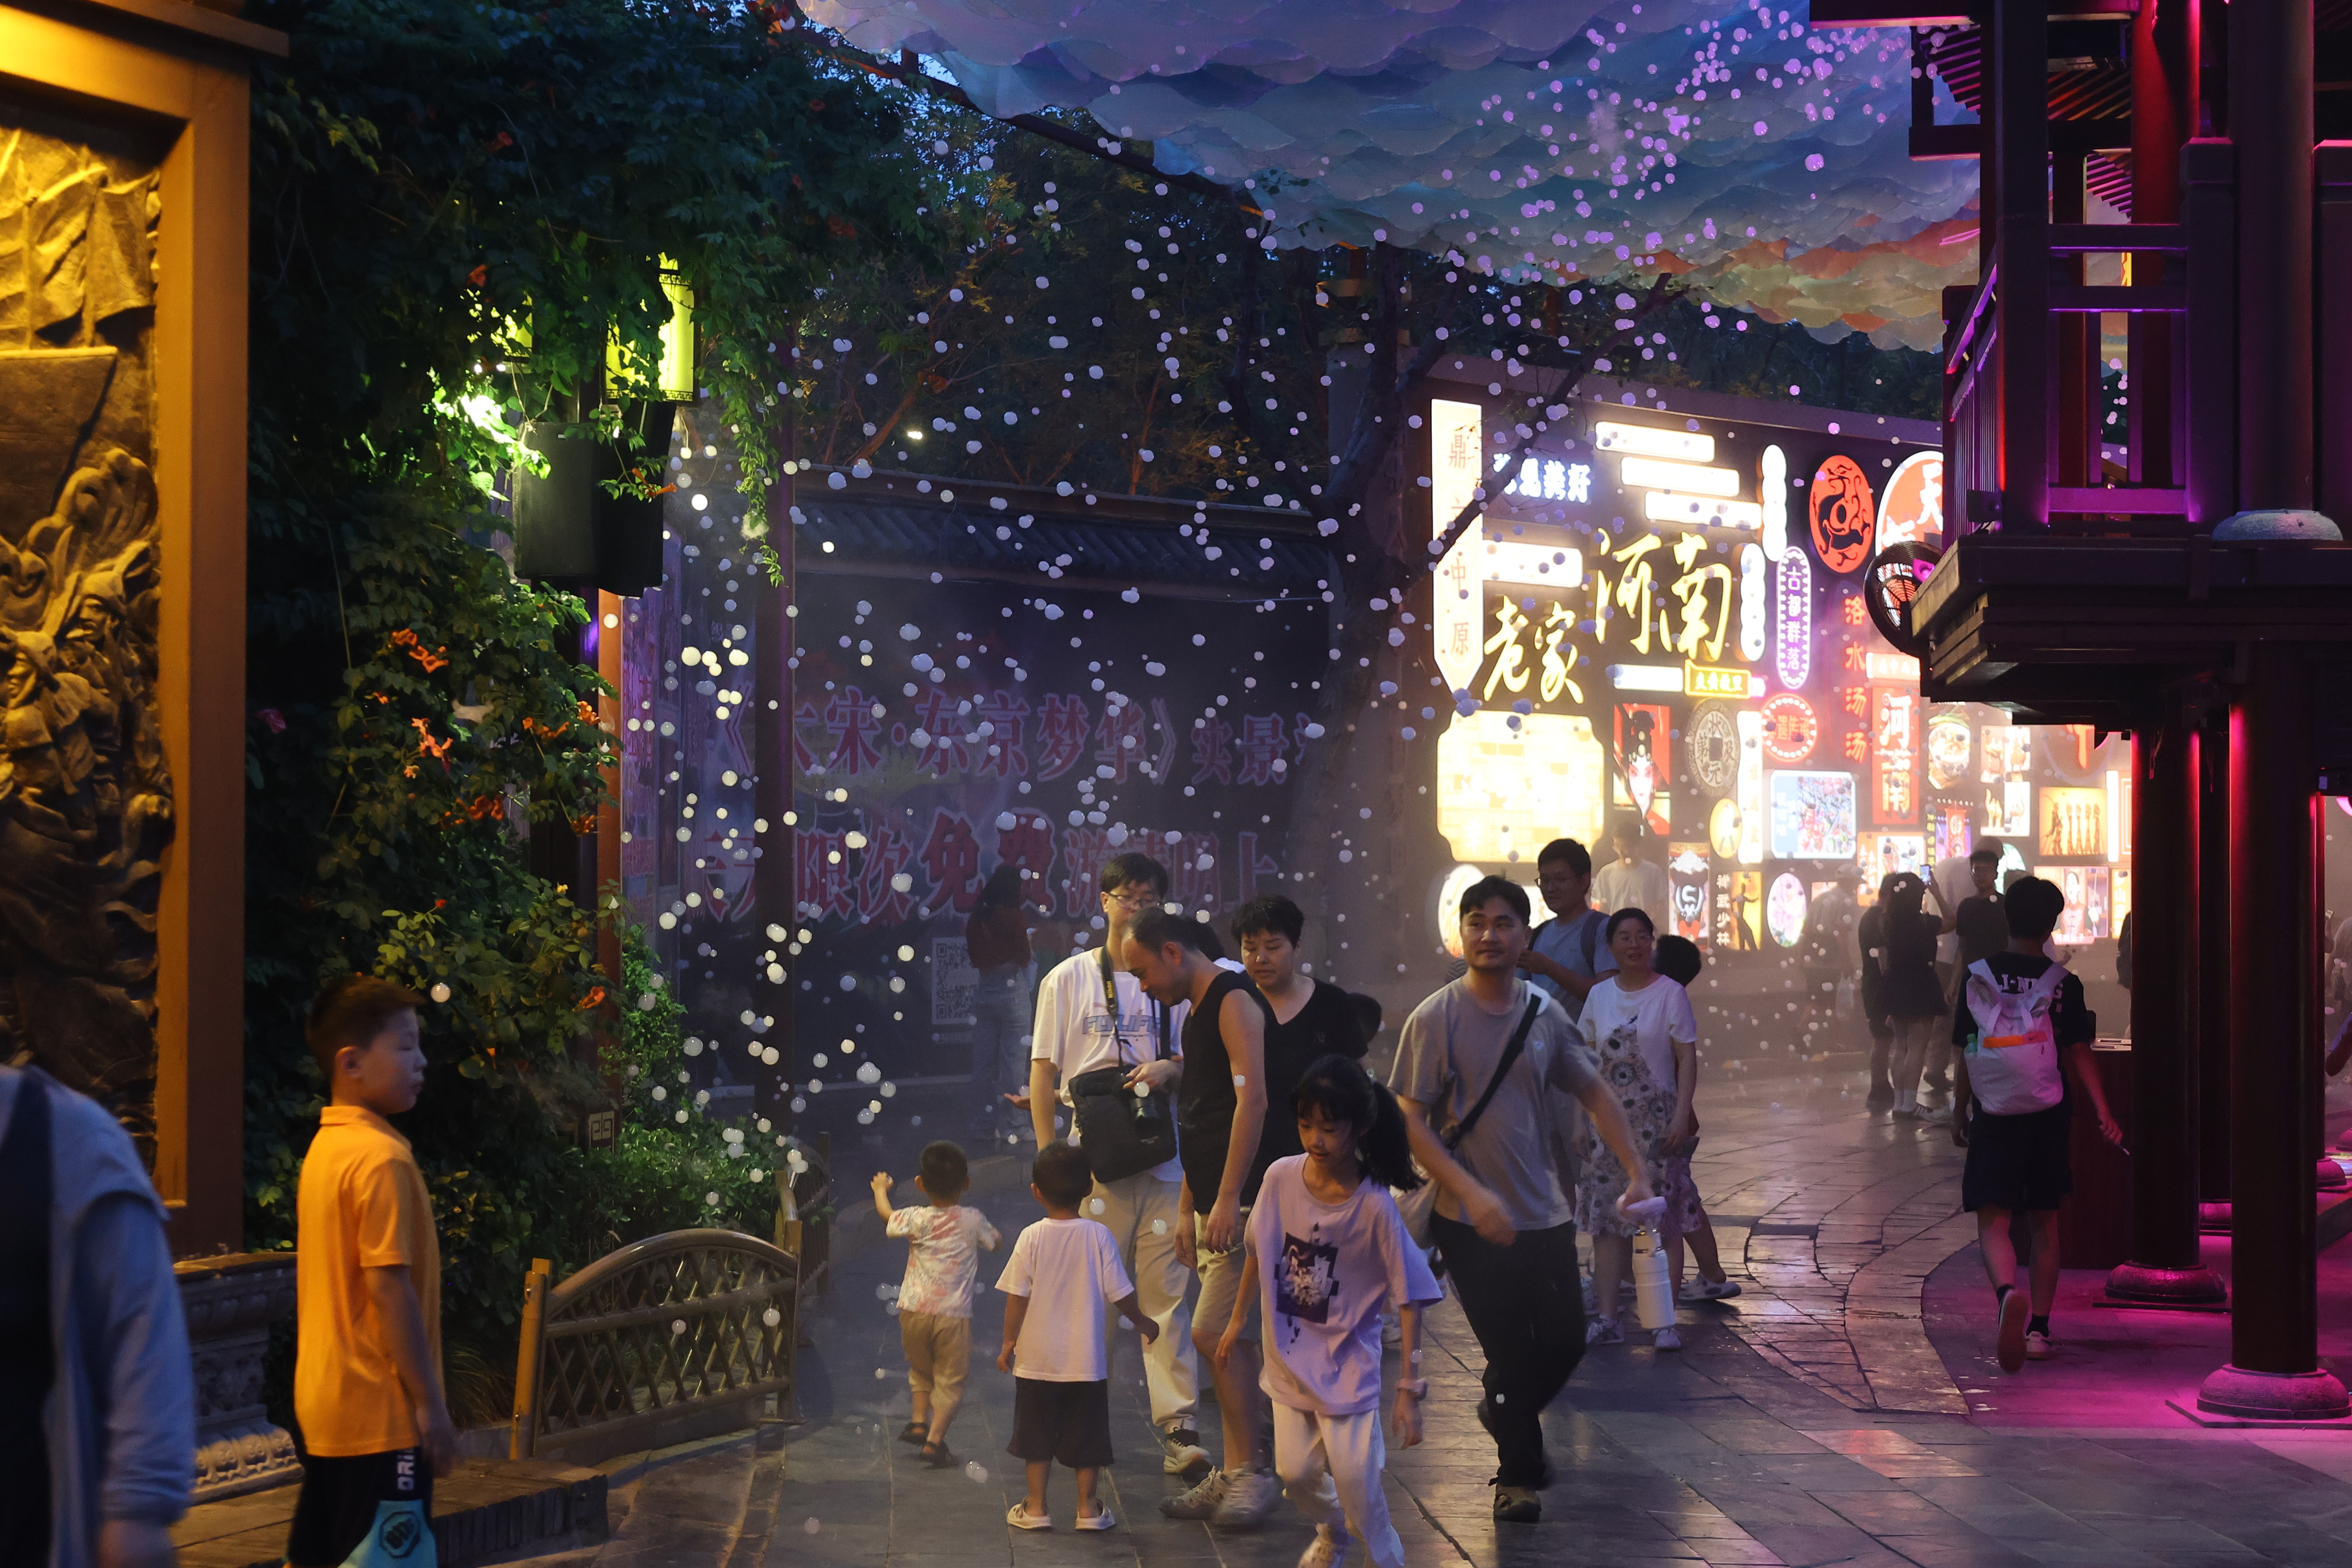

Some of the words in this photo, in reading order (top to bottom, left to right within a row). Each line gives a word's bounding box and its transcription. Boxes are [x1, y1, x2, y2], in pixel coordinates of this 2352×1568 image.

[1785, 565, 1801, 671] 古都群落
[1844, 595, 1868, 764] 洛水汤汤
[1765, 714, 1810, 741] 非遗传承
[1715, 873, 1730, 946] 禅武少林
